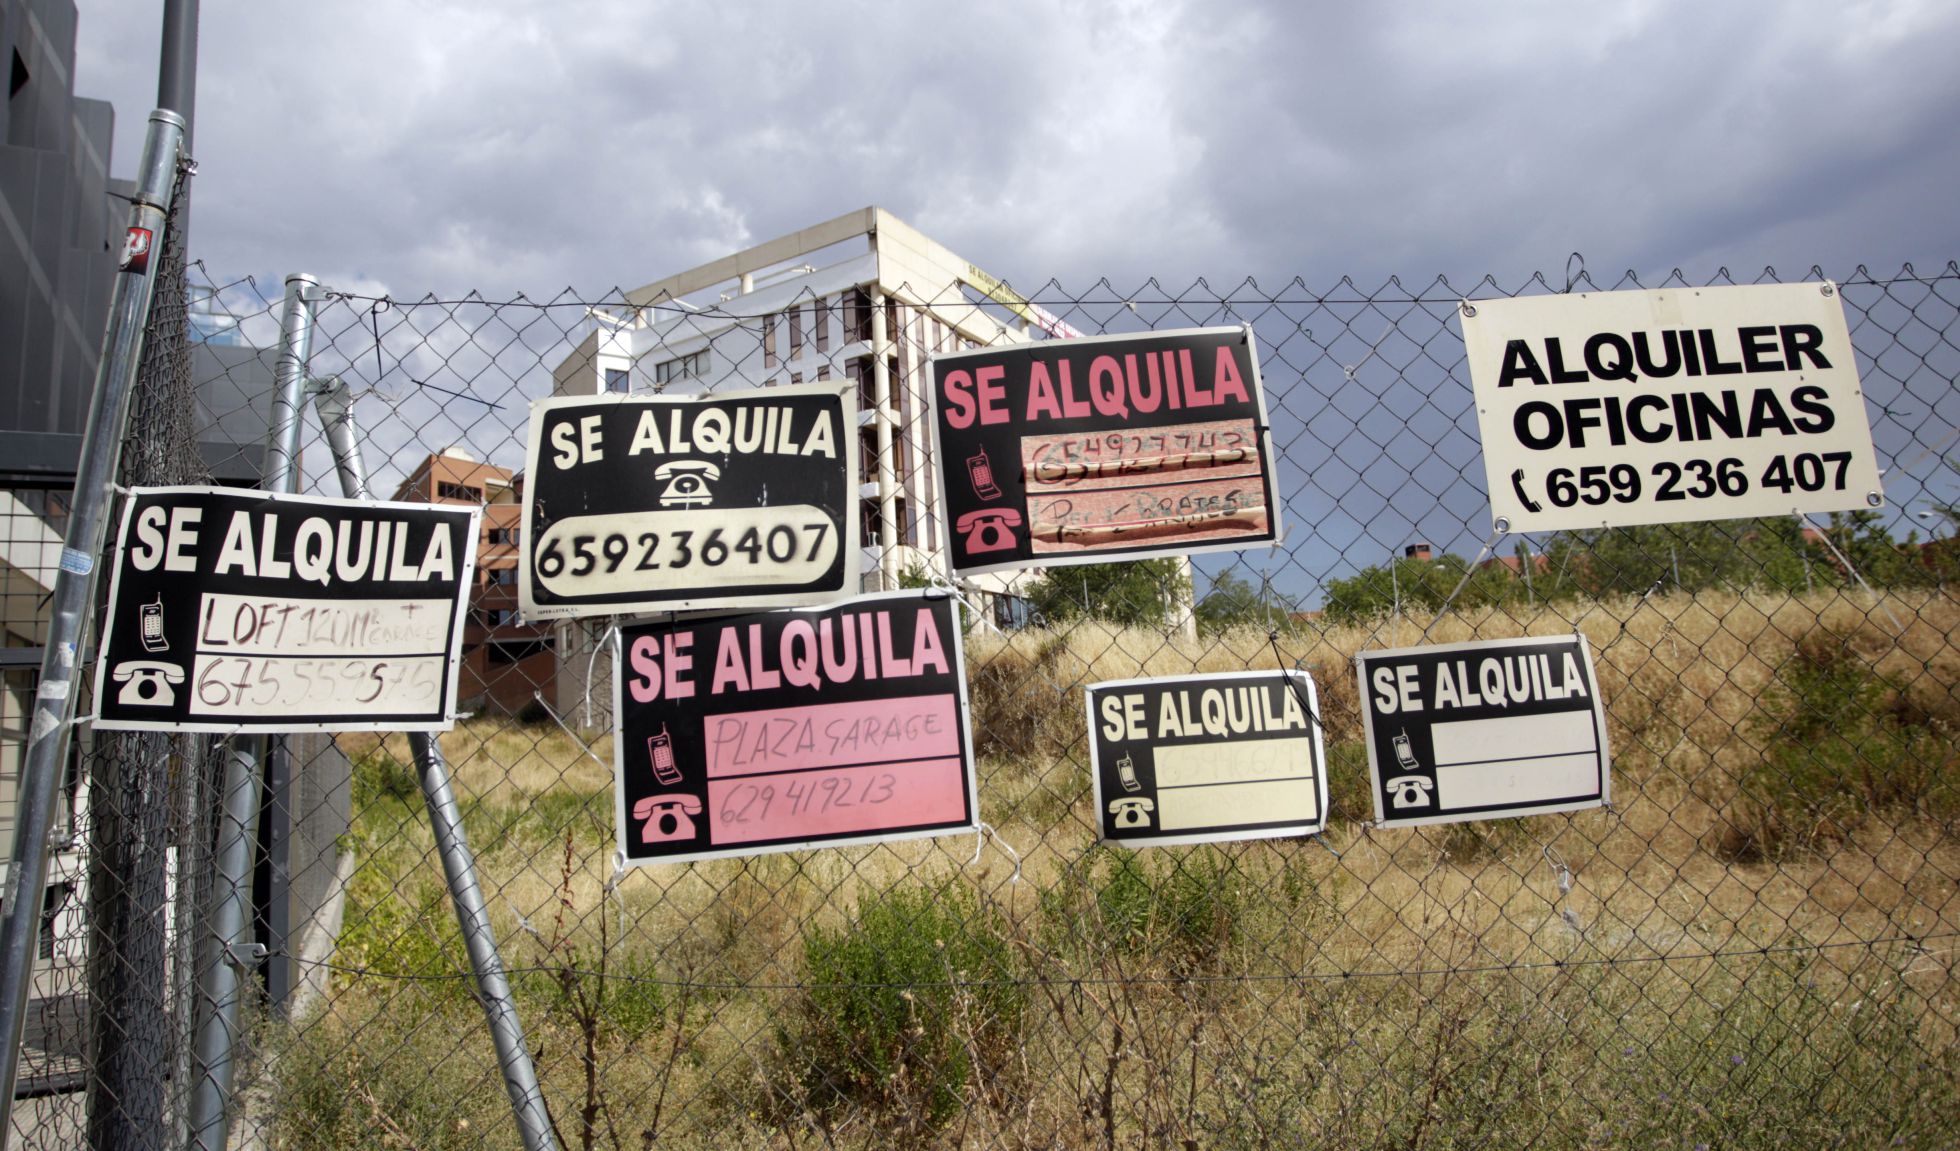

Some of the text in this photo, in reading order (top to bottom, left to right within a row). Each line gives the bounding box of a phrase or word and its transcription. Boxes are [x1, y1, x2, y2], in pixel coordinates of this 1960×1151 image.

[943, 345, 1250, 430] SE ALQUILA
[1497, 323, 1834, 388] ALQUILER
[550, 406, 837, 471] SE ALQUILA
[1513, 384, 1836, 451] OFICINAS
[1545, 451, 1853, 508] 659 236 407
[131, 505, 454, 587] SE ALQUILA
[537, 523, 829, 579] 659236407
[202, 598, 300, 648] LOFT
[629, 608, 949, 704] SE ALQUILA
[1373, 652, 1588, 715] SE ALQUILA
[713, 716, 815, 769] PLAZA
[1101, 685, 1307, 743] SE ALQUILA
